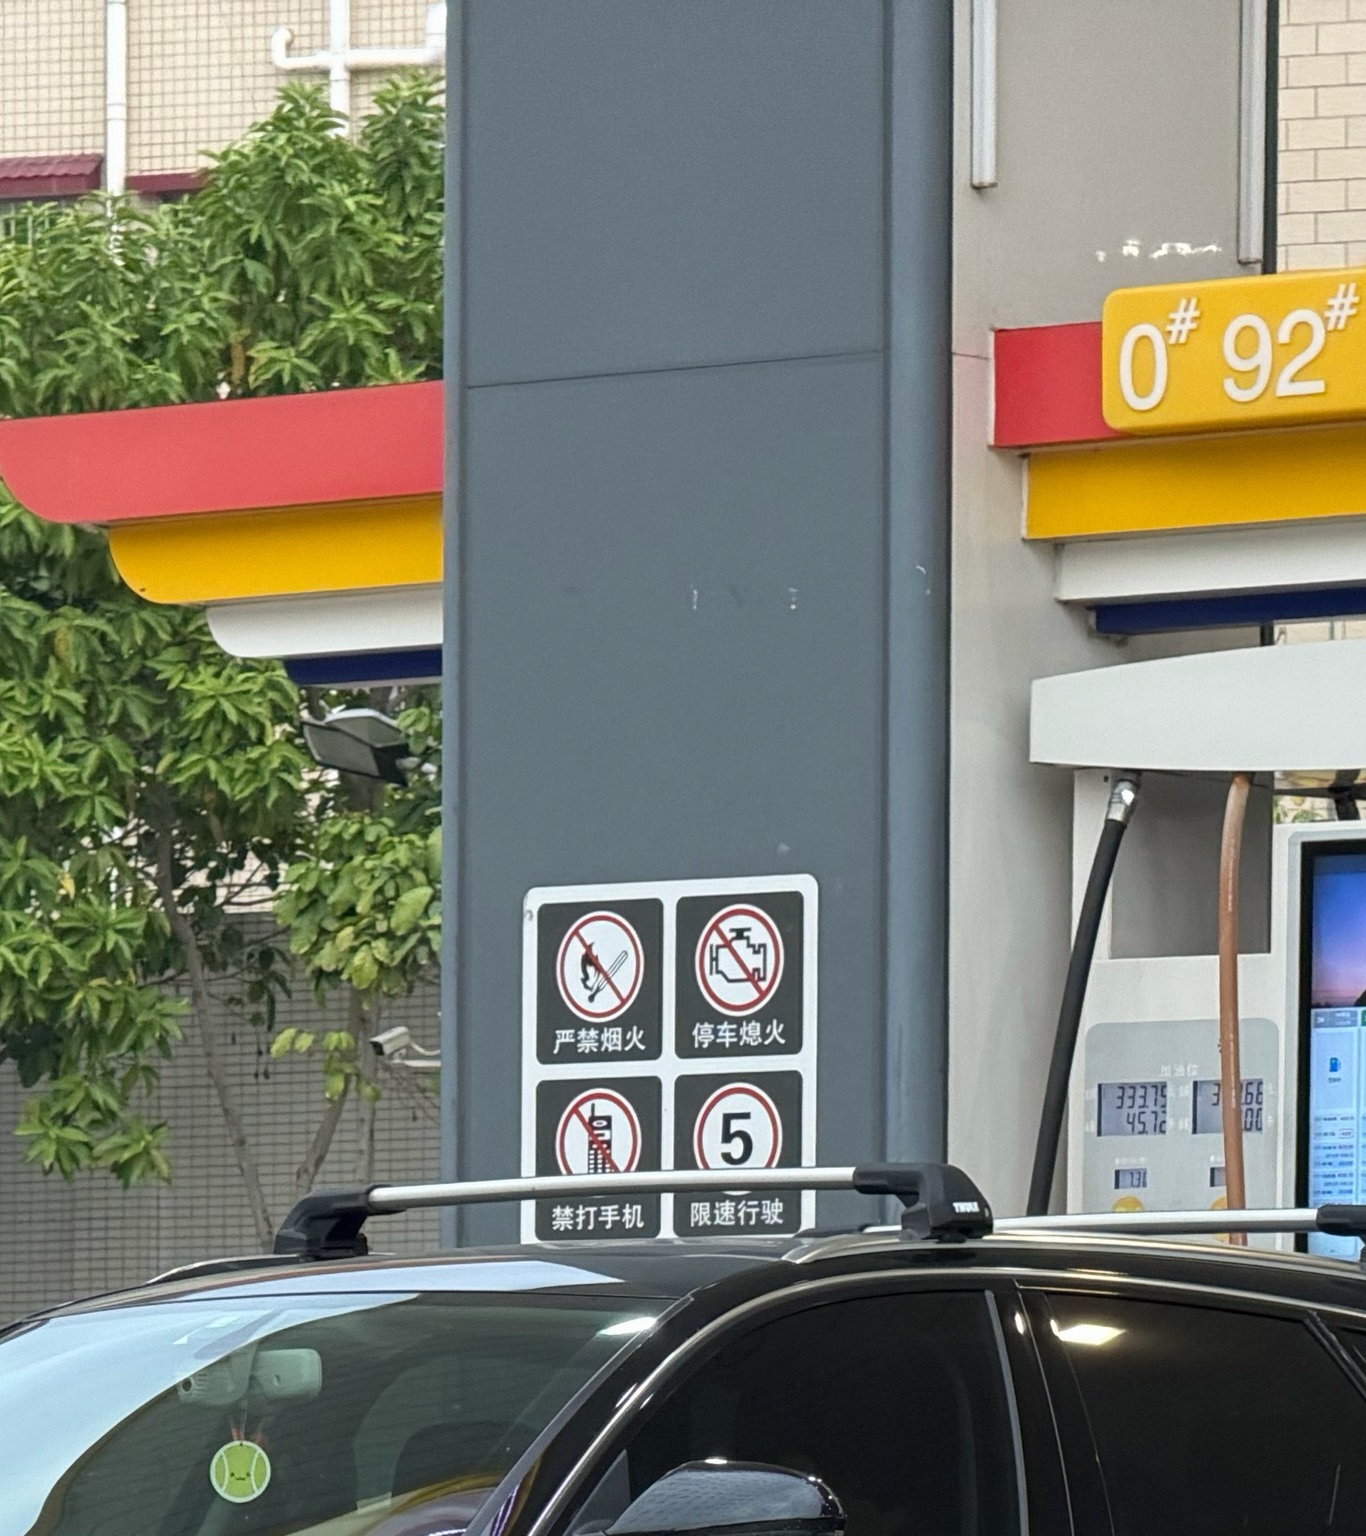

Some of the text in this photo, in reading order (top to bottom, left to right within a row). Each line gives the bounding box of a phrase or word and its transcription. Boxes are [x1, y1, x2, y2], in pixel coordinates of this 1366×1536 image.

[1119, 297, 1201, 411] 0#
[1222, 282, 1361, 403] 92#
[553, 1025, 646, 1055] 严禁烟火
[692, 1018, 786, 1049] 停车熄火
[720, 1112, 754, 1165] 5
[551, 1203, 645, 1231] 禁打手机
[690, 1198, 784, 1227] 限速行驶
